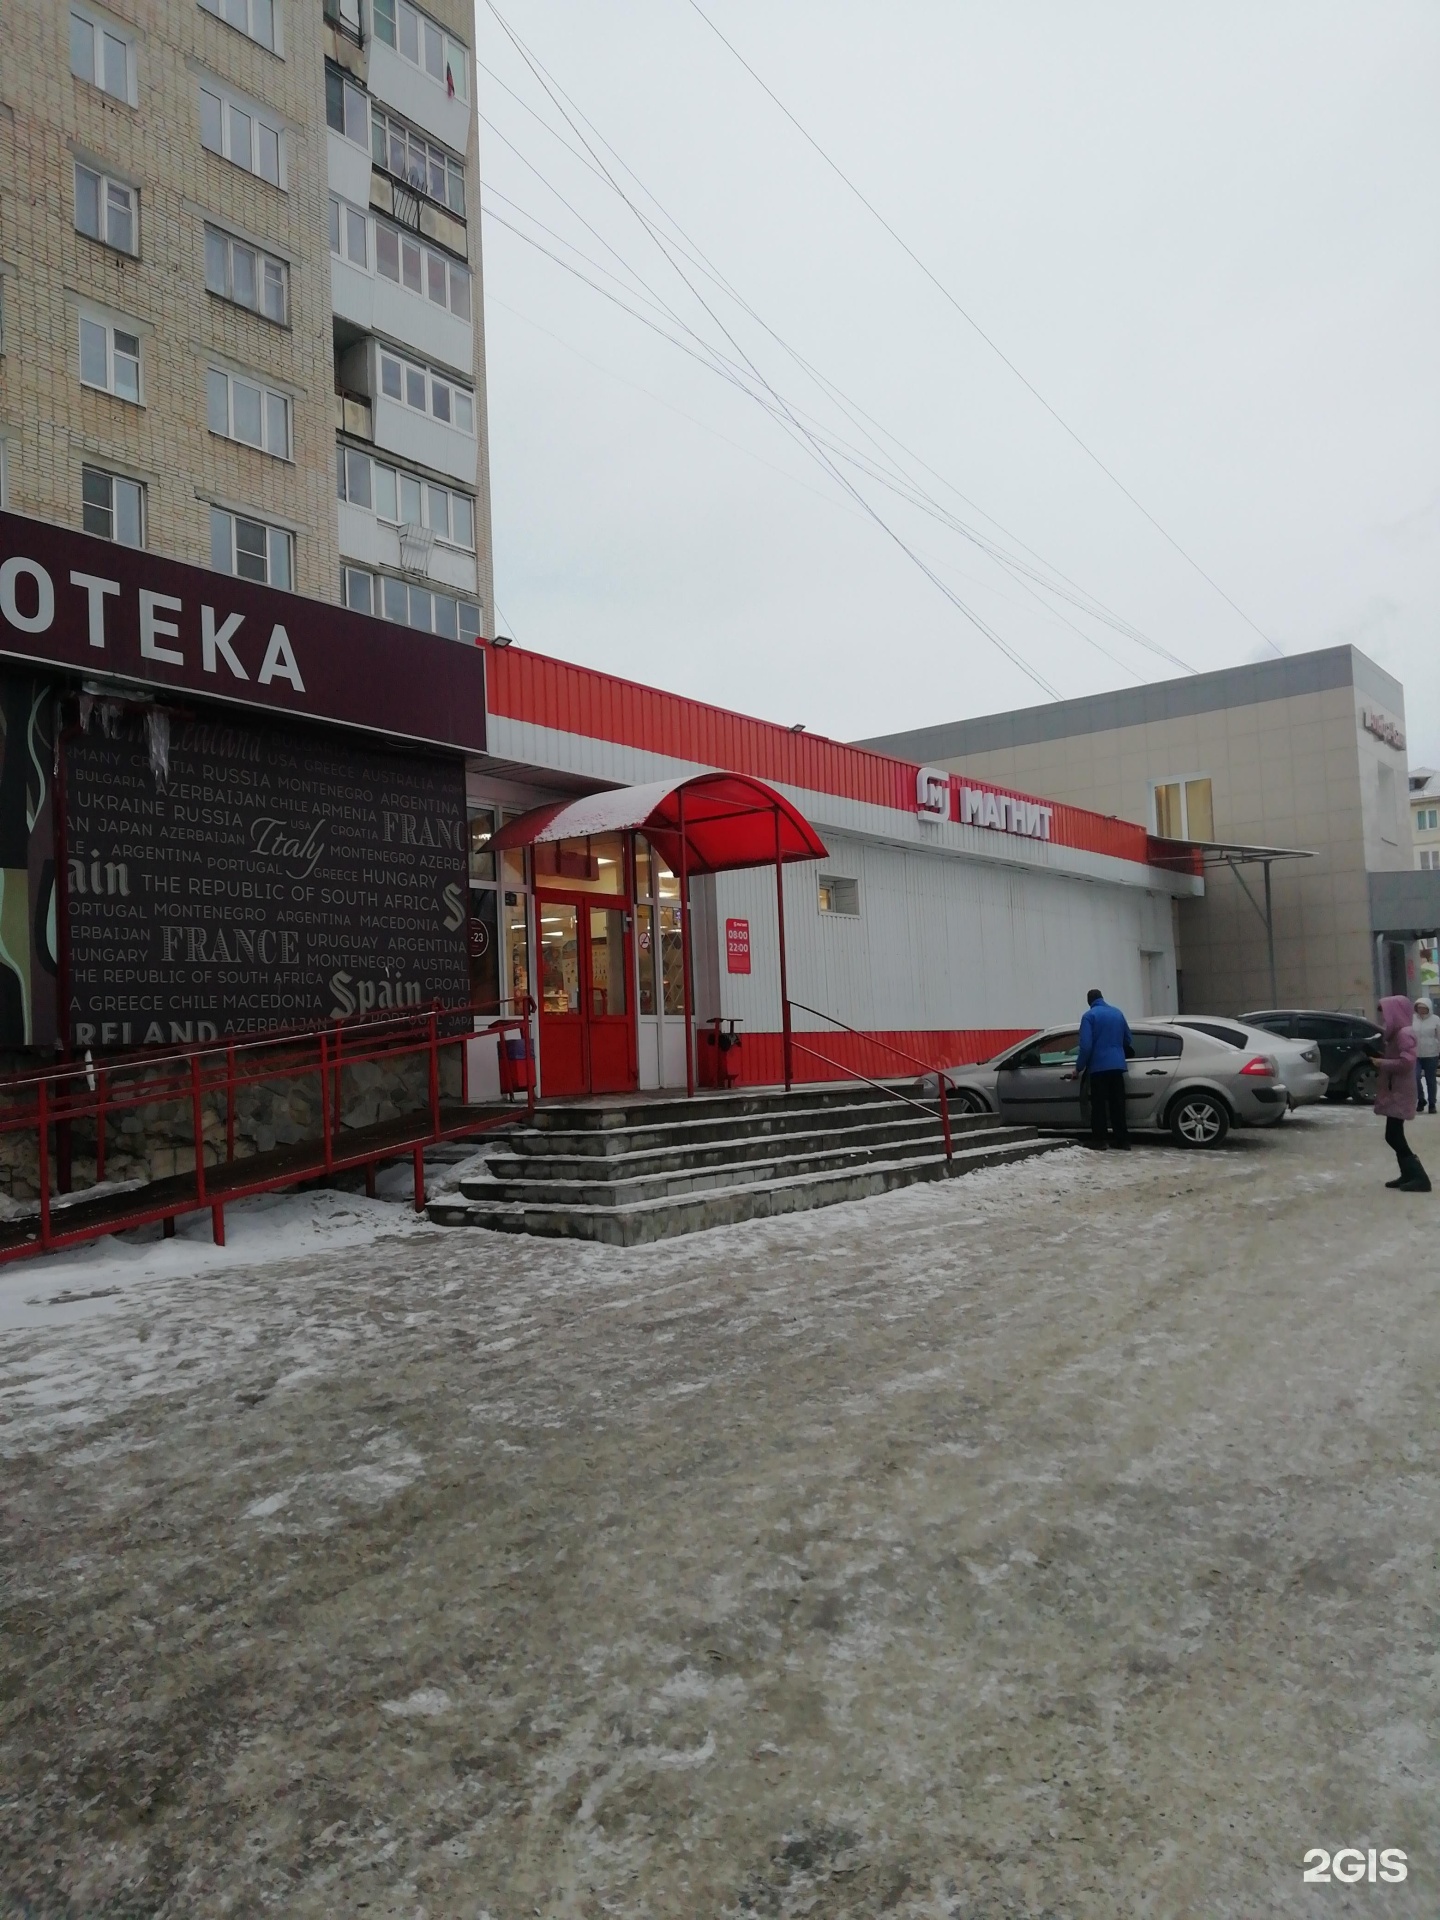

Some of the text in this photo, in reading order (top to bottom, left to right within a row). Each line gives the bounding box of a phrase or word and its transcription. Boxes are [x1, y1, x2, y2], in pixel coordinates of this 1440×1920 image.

[202, 764, 271, 789] RUSSIA
[278, 776, 374, 802] MONTENEGRO
[380, 792, 460, 816] ARGENTINA
[268, 753, 298, 769] USA
[304, 759, 355, 780] GREECE
[362, 768, 435, 791] AUSTRALIA
[75, 768, 146, 789] BULGARIA
[156, 782, 266, 808] AZERBAIJAN
[270, 796, 308, 813] CHILE
[312, 802, 377, 823] ARMENIA
[960, 787, 1053, 839] МАГНИТ
[78, 791, 379, 840] UKRAINE RUSSIA USA CROATIA
[98, 818, 153, 837] JAPAN
[159, 826, 245, 846] AZERBAIJAN
[330, 846, 416, 867] MONTENEGRO
[250, 817, 326, 880] Italy
[111, 844, 202, 864] ARGENTINA
[207, 857, 283, 876] PORTUGAL
[313, 867, 358, 882] GREECE
[362, 868, 438, 889] HUNGARY
[141, 873, 181, 894] THE
[188, 878, 284, 902] REPUBLIC
[291, 885, 316, 902] OF
[321, 888, 378, 908] SOUTH
[384, 894, 440, 912] AFRICA
[68, 902, 440, 932] ORTUGAL MONTENEGRO ARGENTINA MACEDONIA
[70, 925, 467, 964] ERBAIJAN FRANCE URUGUAY ARGENTINA
[307, 953, 406, 970] MONTENEGRO
[412, 957, 467, 972] AUSTRAL
[729, 943, 749, 952] 22:00
[69, 968, 471, 992] HE REPUBLIC OF SOUTH AFRICA CROATI
[328, 970, 422, 1025] Spain
[89, 995, 163, 1011] GREECE
[169, 994, 218, 1010] CHILE
[223, 994, 323, 1010] MACEDONIA
[224, 1016, 328, 1034] AZERBAIJAN
